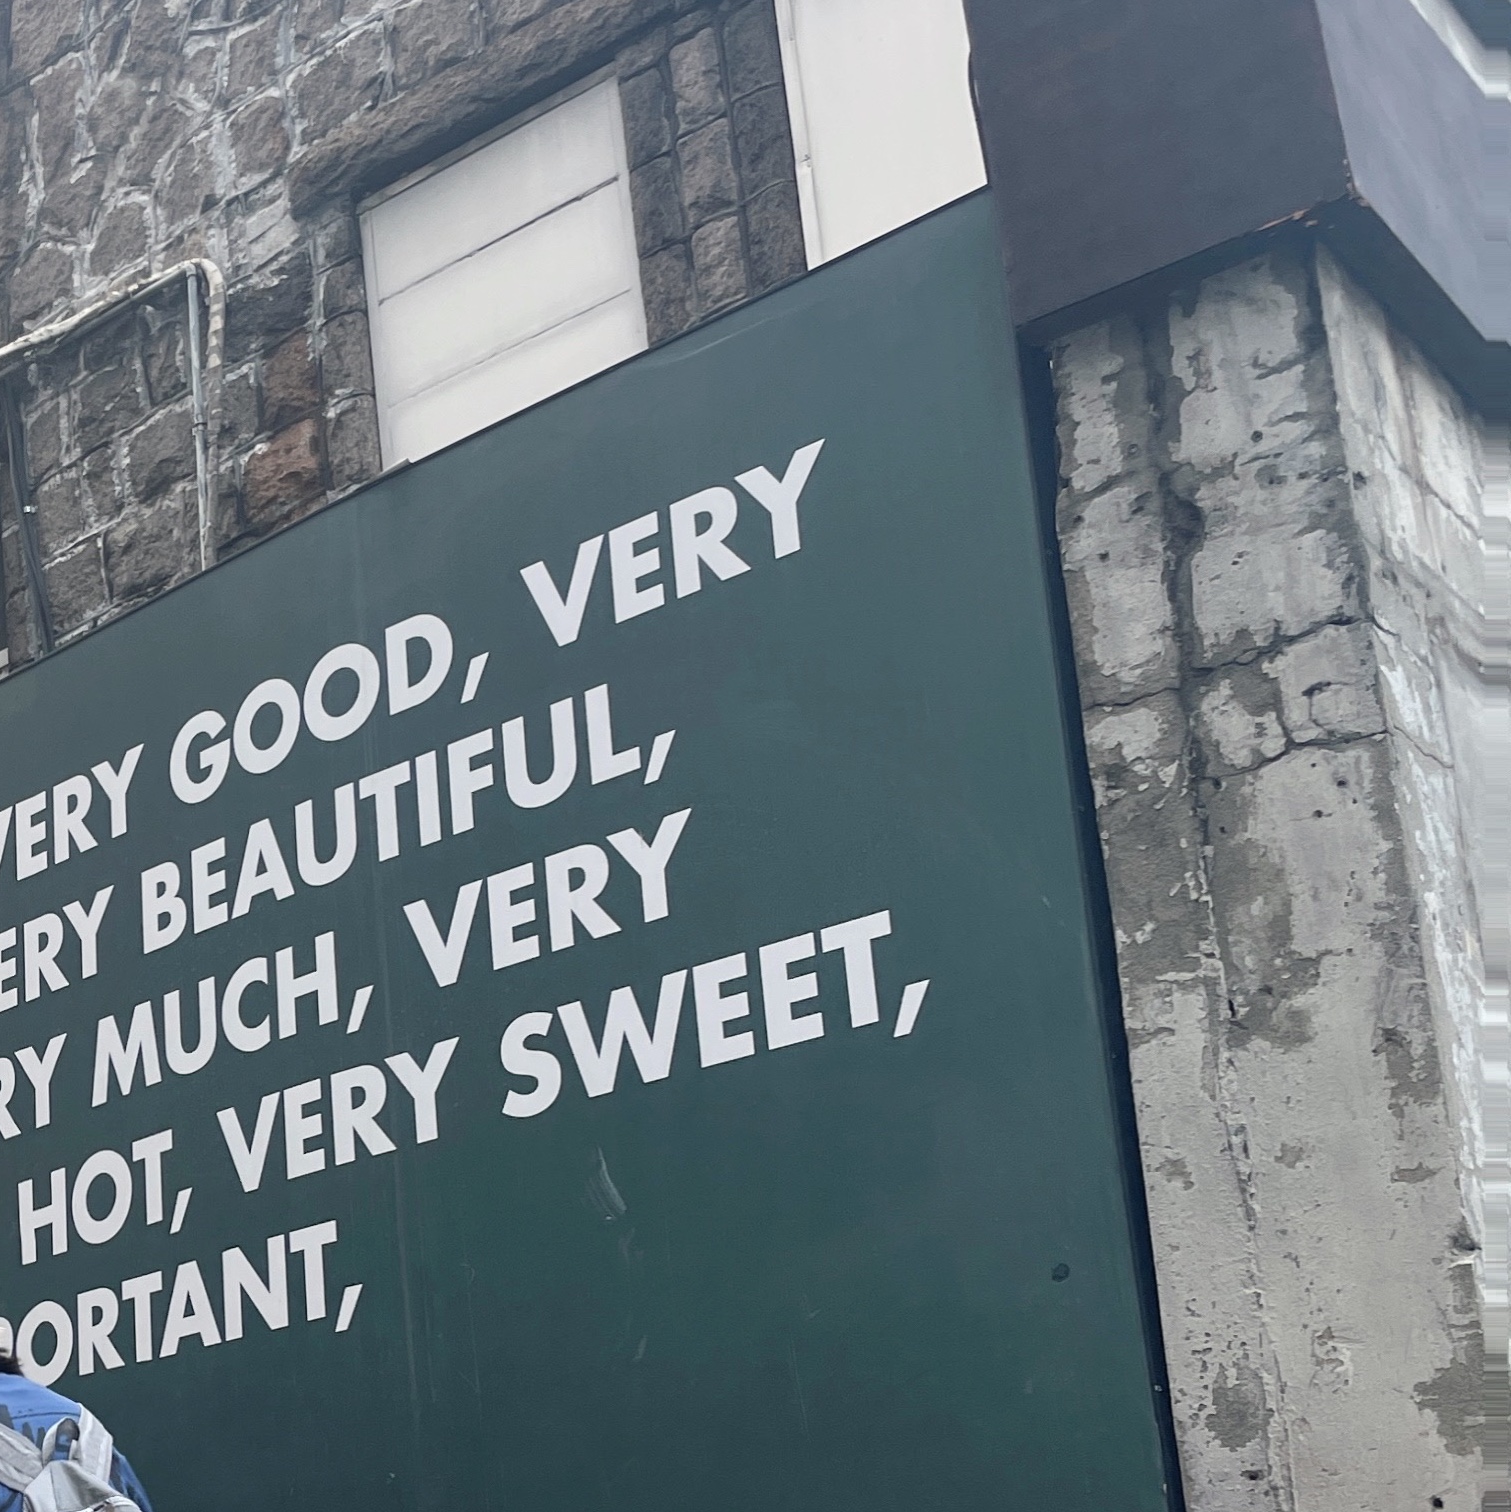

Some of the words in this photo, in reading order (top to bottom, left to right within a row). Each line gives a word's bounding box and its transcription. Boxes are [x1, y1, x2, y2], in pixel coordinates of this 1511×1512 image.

[170, 614, 490, 803] GOOD,
[520, 439, 825, 646] VERY
[92, 932, 374, 1107] MUCH,
[403, 808, 691, 987] VERY
[141, 684, 675, 954] BEAUTIFUL,
[18, 1129, 192, 1265] HOT,
[217, 1037, 459, 1192] VERY
[501, 910, 930, 1117] SWEET,
